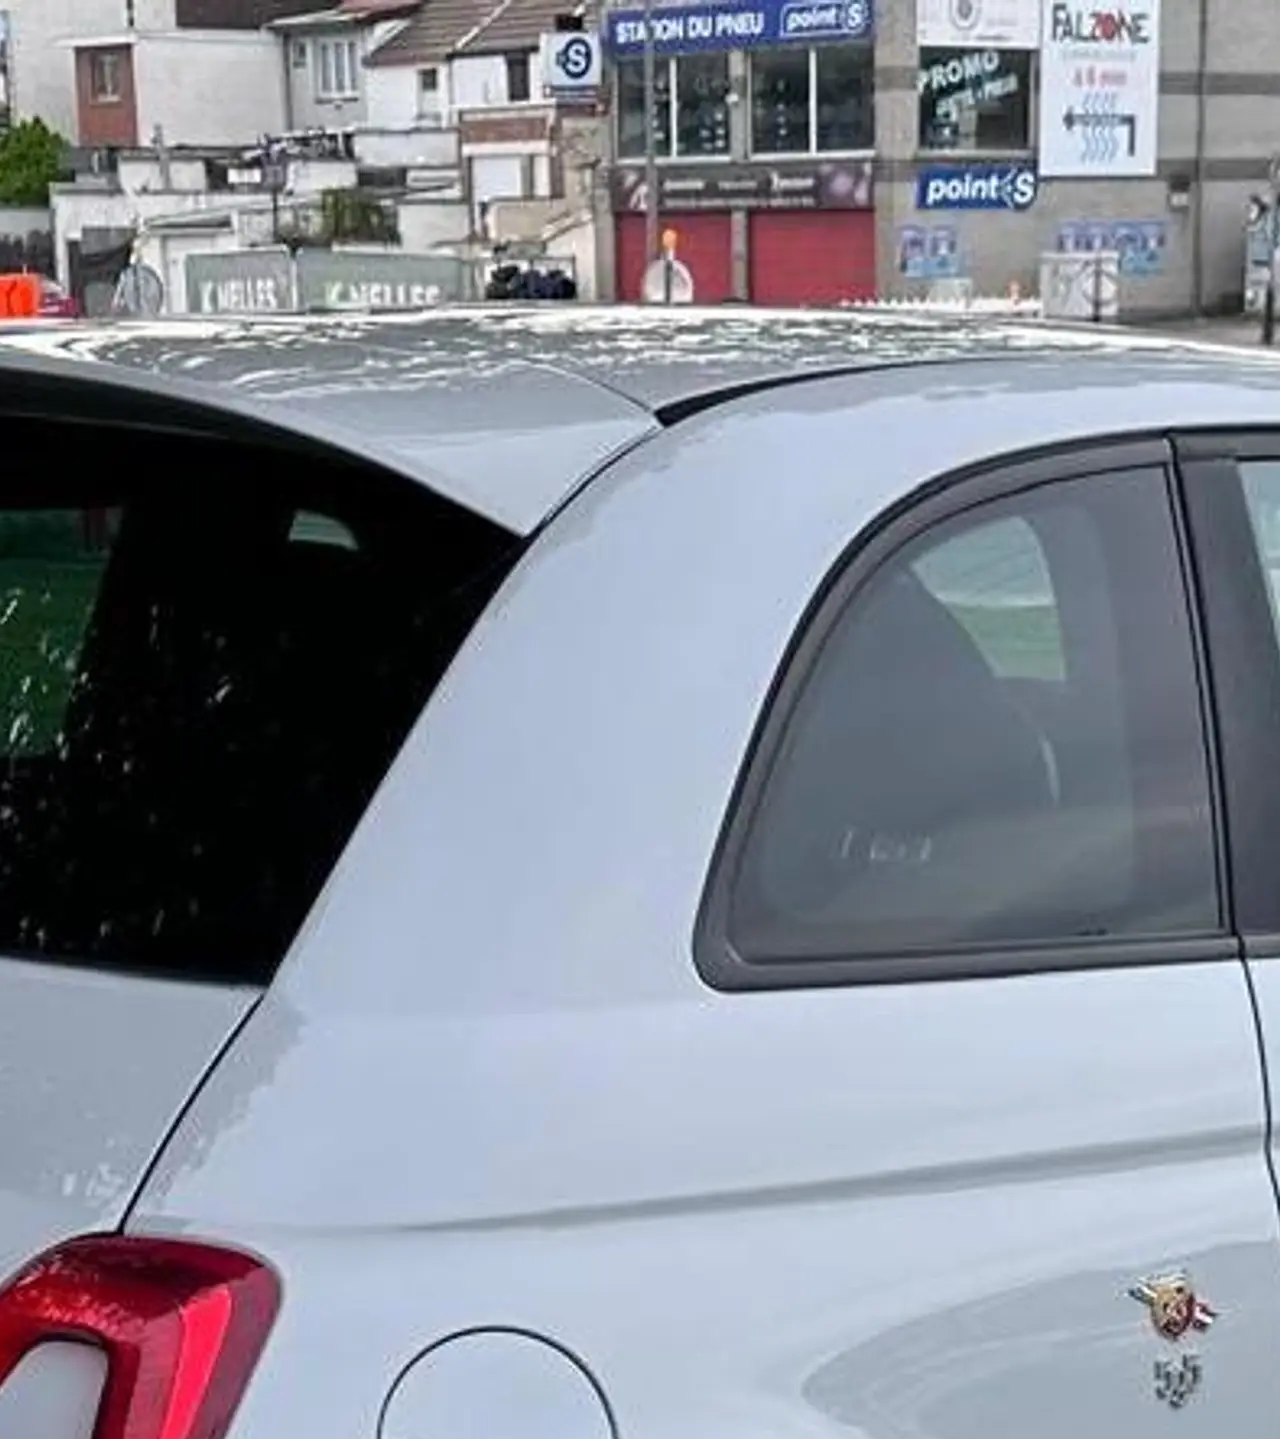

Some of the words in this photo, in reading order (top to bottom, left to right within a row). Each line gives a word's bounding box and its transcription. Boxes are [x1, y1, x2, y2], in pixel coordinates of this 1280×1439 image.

[686, 16, 713, 39] DU
[1051, 2, 1150, 44] FALZONE
[916, 50, 1000, 96] PROMO
[927, 172, 1004, 206] point
